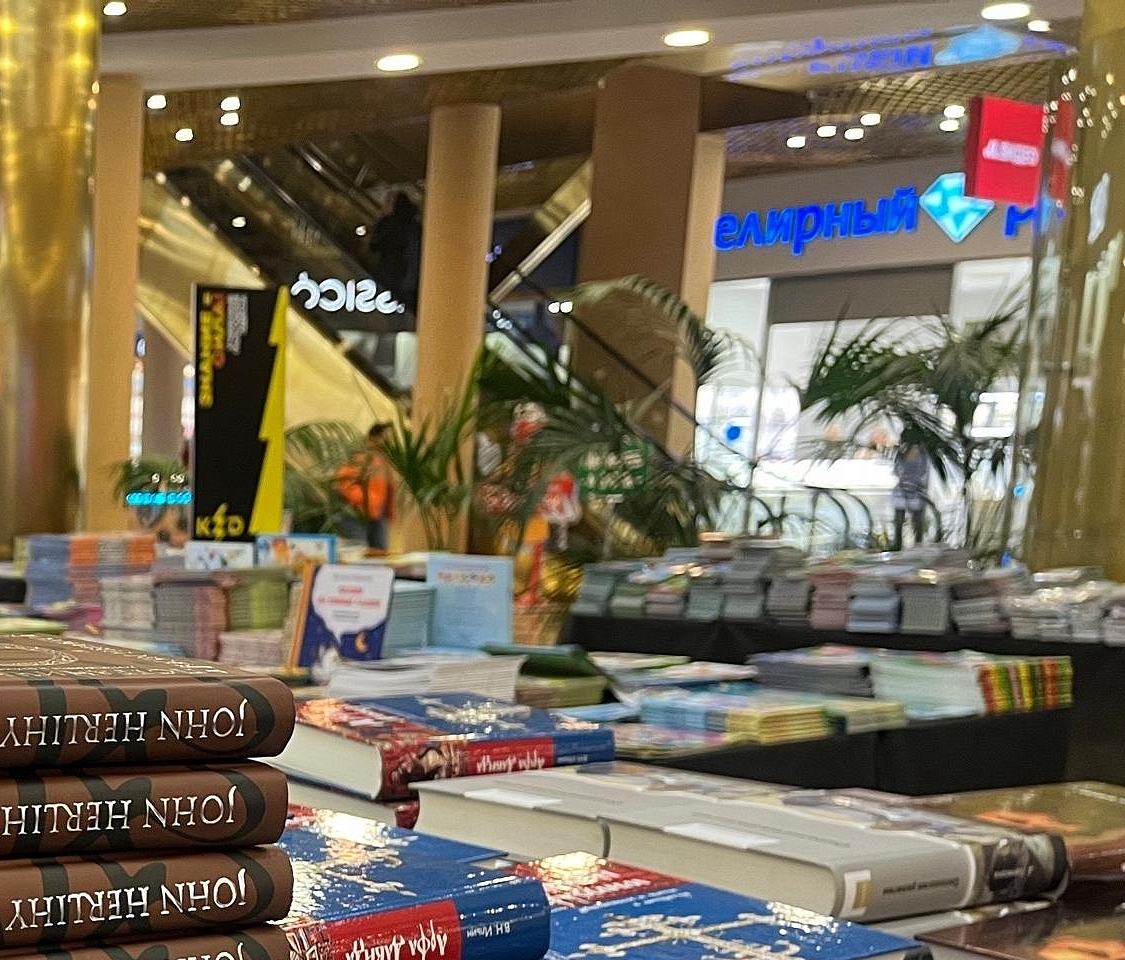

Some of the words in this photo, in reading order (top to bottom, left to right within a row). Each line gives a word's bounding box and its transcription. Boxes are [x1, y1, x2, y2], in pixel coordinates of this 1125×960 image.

[158, 698, 247, 741] JOHN
[143, 785, 236, 828] JOHN
[4, 885, 150, 931] HERLIHY
[161, 868, 247, 914] JOHN
